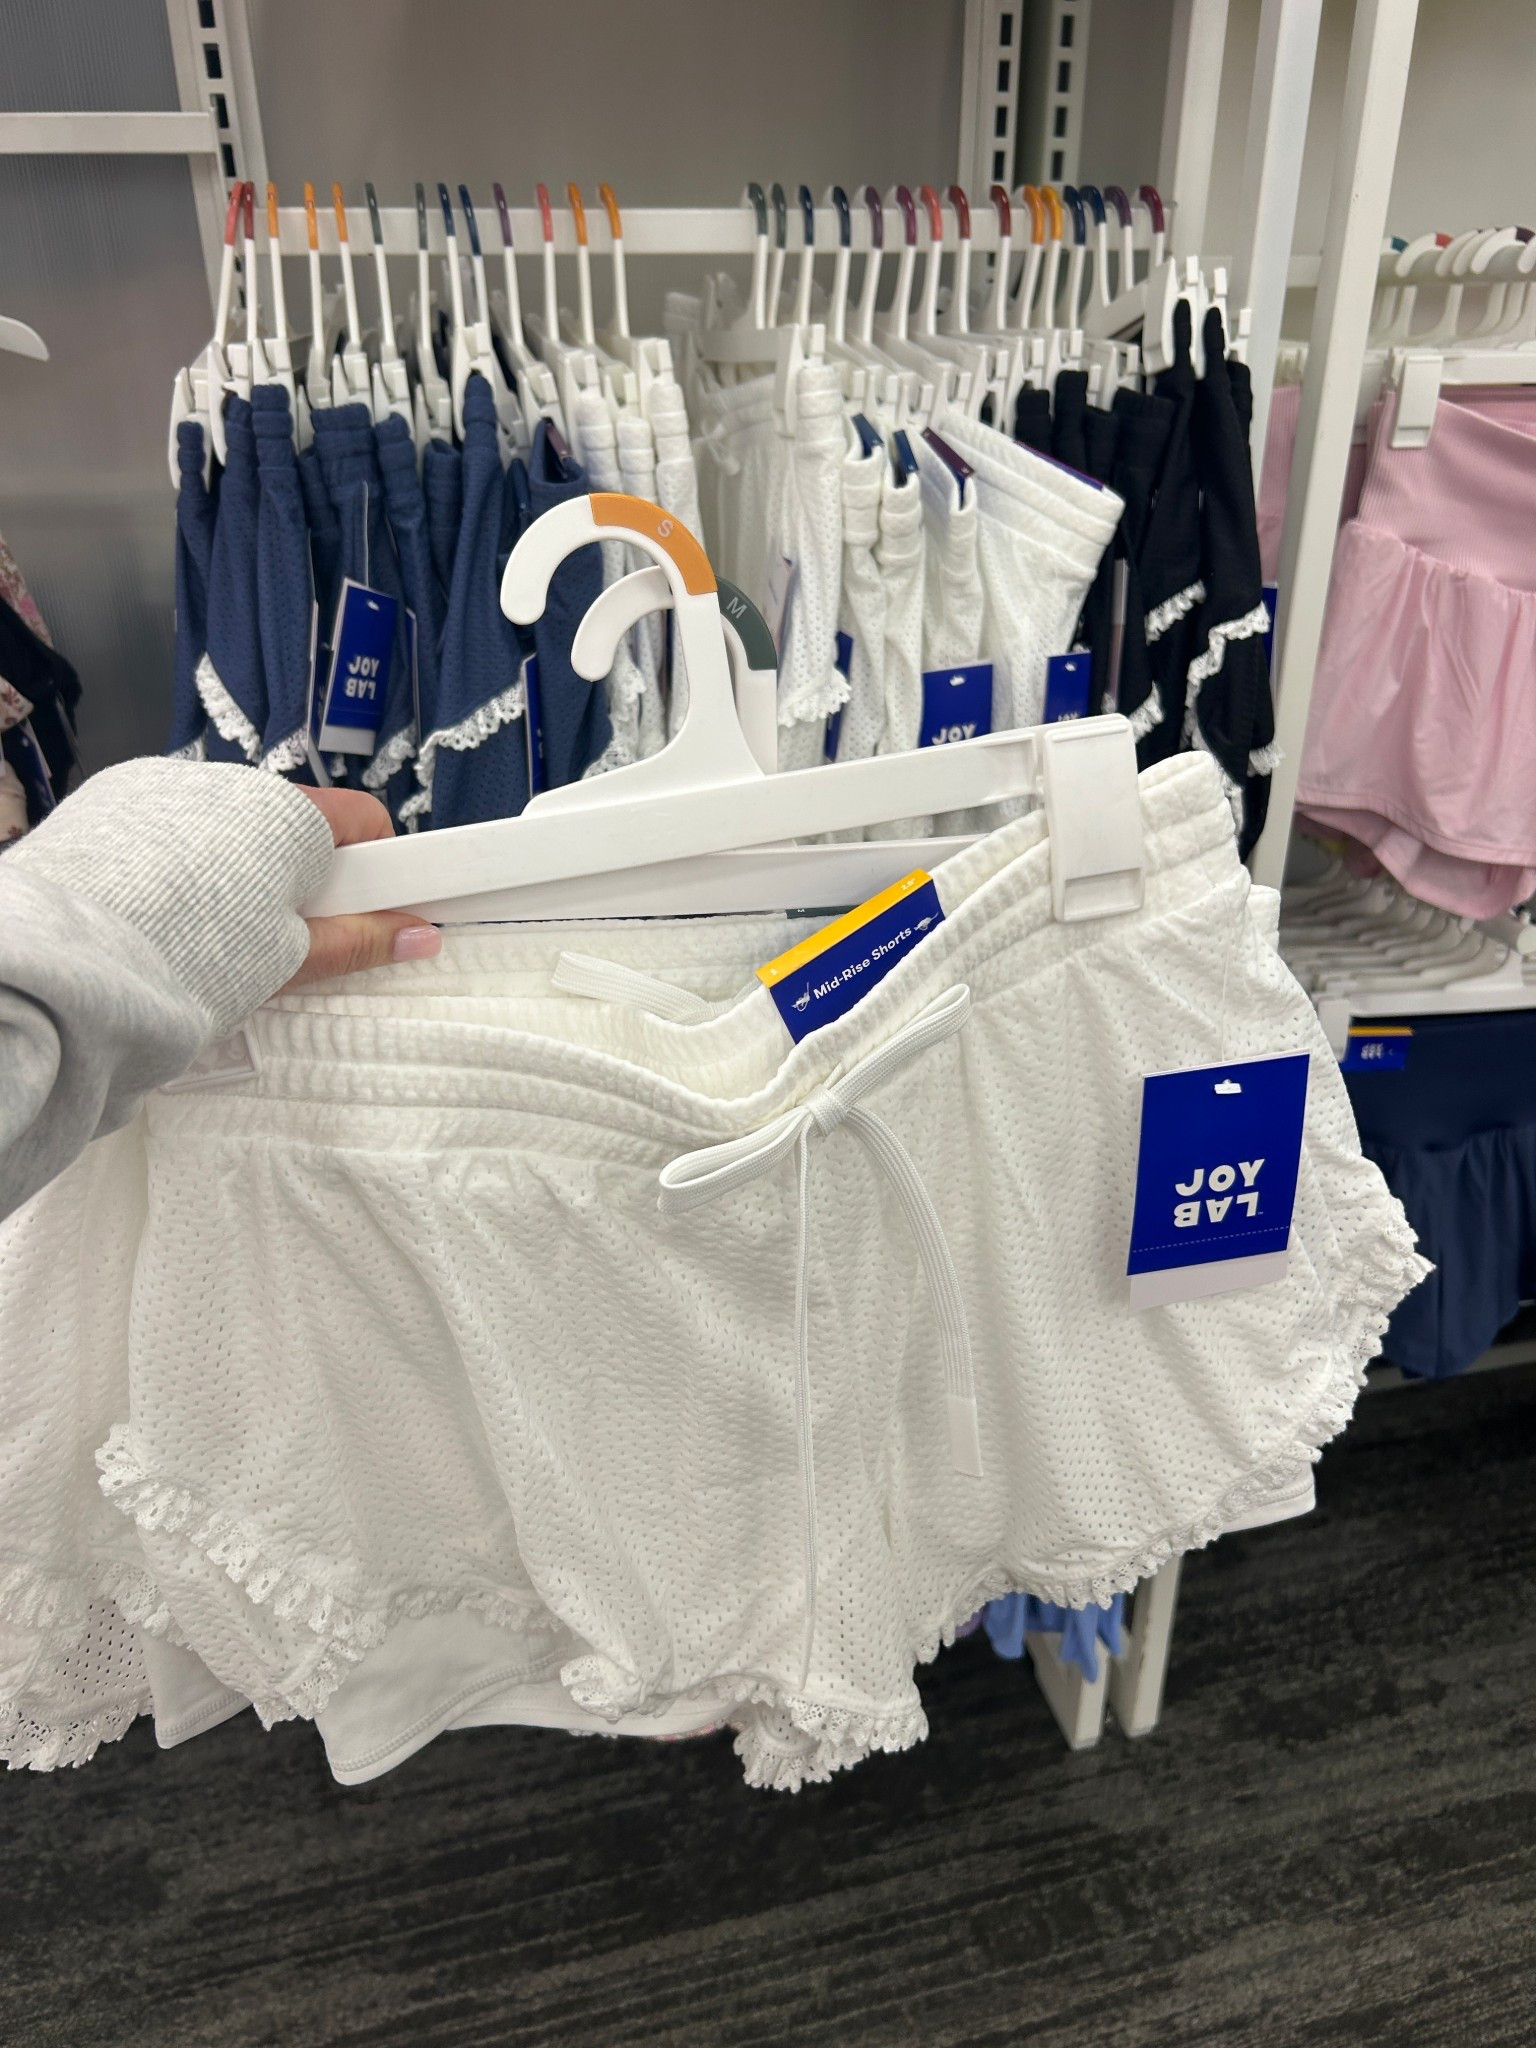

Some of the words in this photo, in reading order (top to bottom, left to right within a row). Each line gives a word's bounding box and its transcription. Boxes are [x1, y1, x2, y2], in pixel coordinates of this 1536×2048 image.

[657, 519, 674, 538] S
[726, 597, 748, 619] M
[349, 656, 380, 678] JOY
[346, 678, 377, 700] LAB
[932, 723, 977, 745] JOY
[813, 957, 871, 999] Mid-Rise
[871, 927, 912, 961] Shorts
[1175, 1158, 1265, 1197] JOY
[1173, 1191, 1259, 1228] LAB
